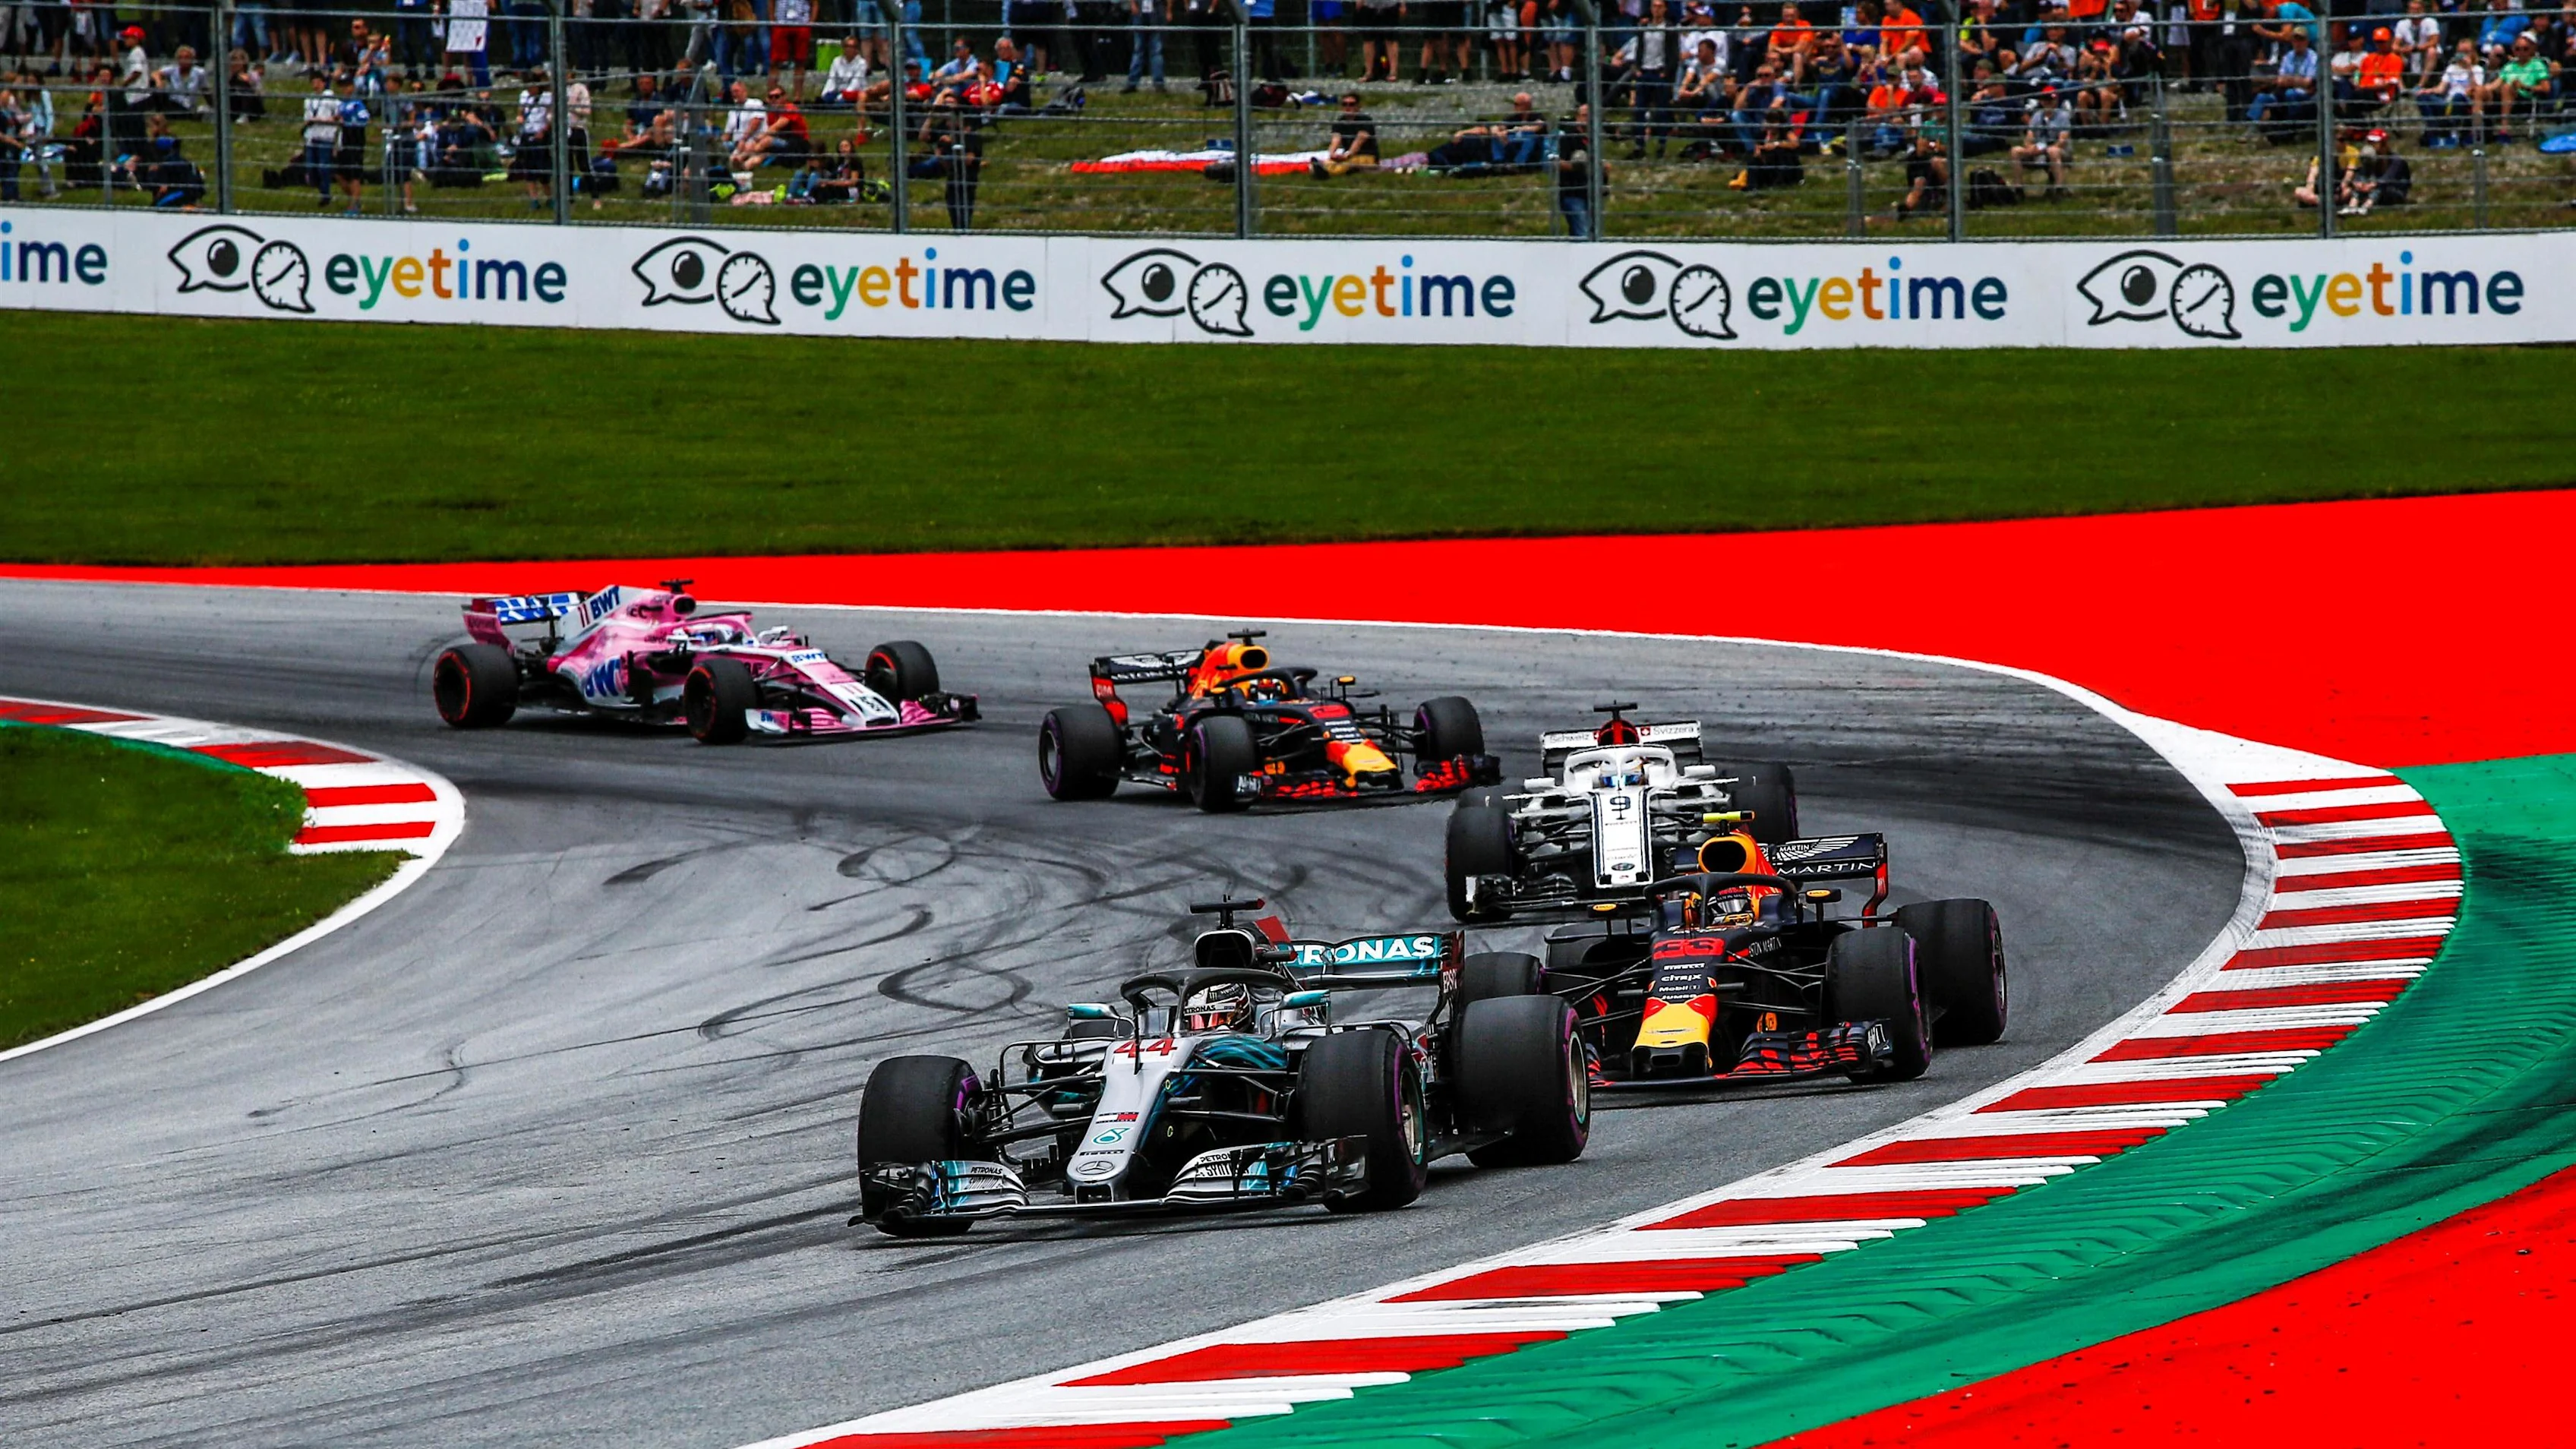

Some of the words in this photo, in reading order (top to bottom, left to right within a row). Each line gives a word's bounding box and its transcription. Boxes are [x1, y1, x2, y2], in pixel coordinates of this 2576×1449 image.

[325, 238, 567, 311] eyetime
[791, 248, 1035, 320] eyetime
[1264, 255, 1515, 331] eyetime
[1747, 257, 2007, 335] eyetime
[2252, 251, 2524, 333] eyetime
[590, 586, 620, 620] BWT
[1549, 733, 1589, 743] Schweiz
[1653, 726, 1694, 736] Svizzera
[1609, 796, 1631, 812] 9
[1777, 862, 1876, 874] MARTIN
[1290, 936, 1435, 966] TRONAS
[1653, 937, 1725, 960] 33
[1113, 1038, 1178, 1059] 44
[971, 1166, 1002, 1175] PETRONAS
[1200, 1154, 1231, 1163] PETRO
